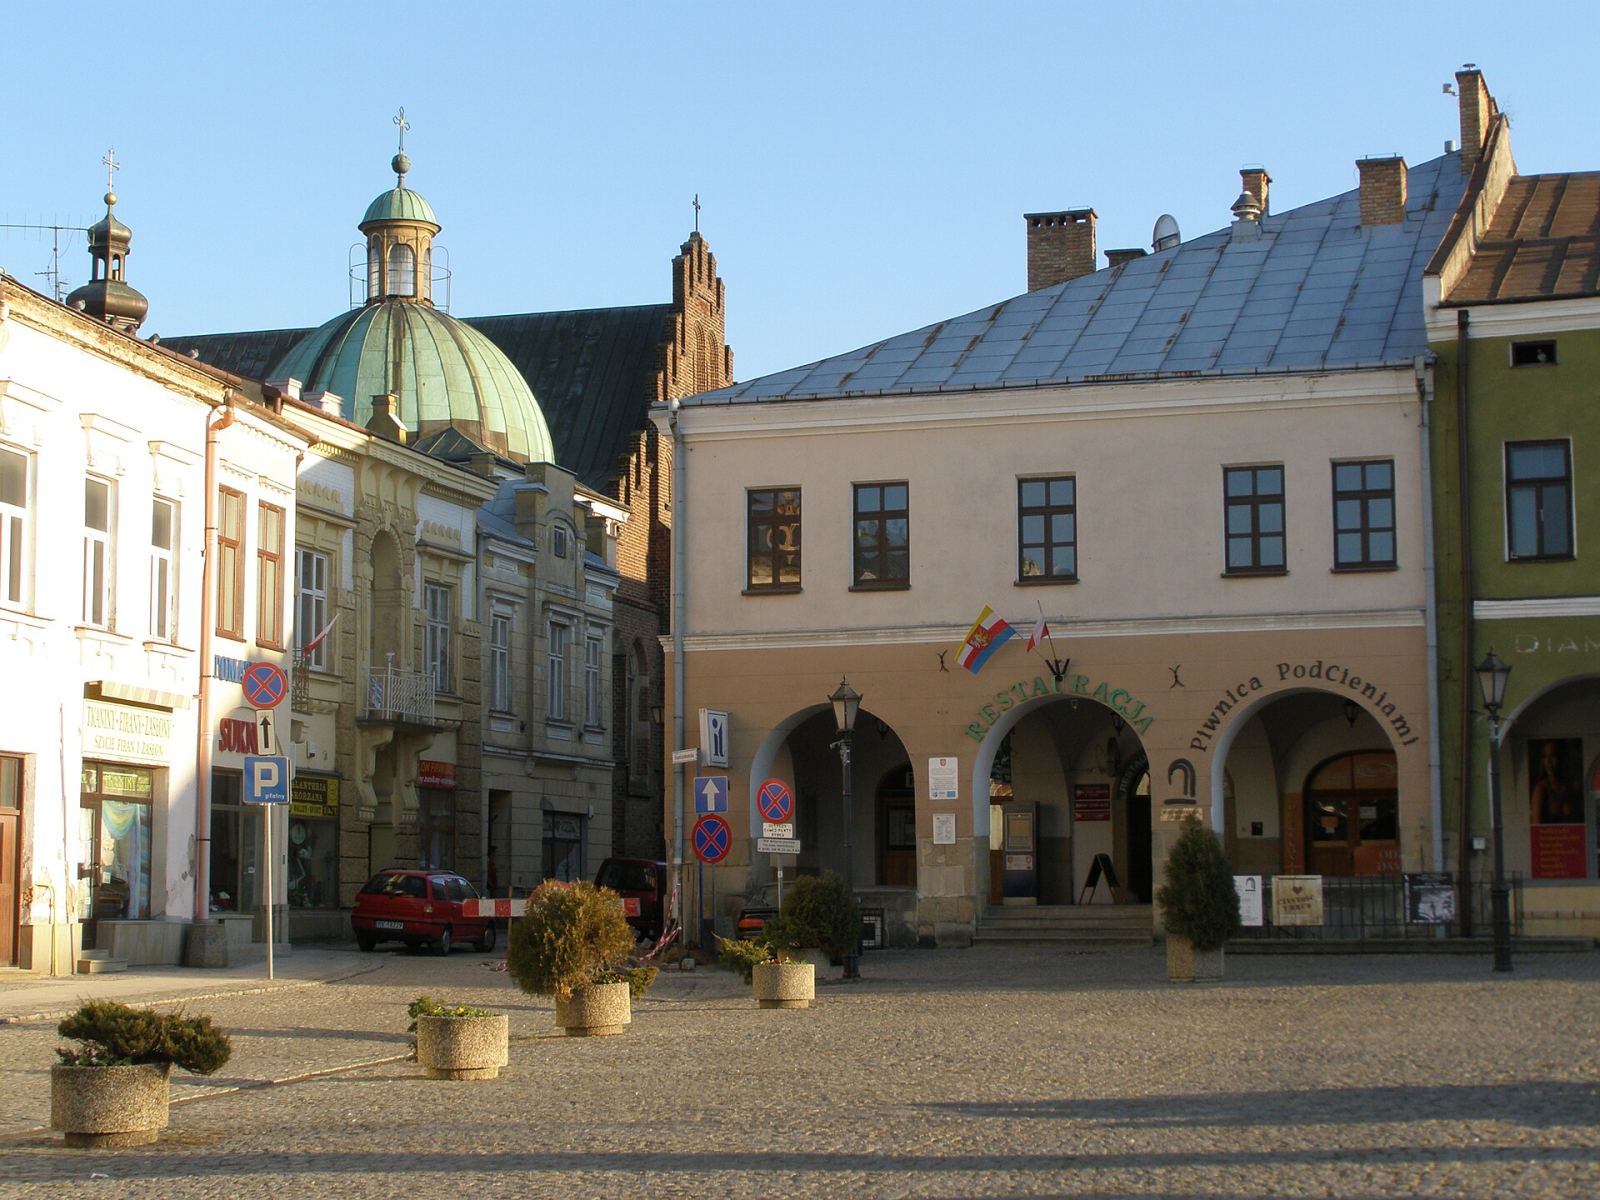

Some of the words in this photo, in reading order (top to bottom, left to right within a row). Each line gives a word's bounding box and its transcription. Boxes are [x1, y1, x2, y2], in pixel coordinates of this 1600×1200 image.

[87, 706, 117, 730] TKANINY
[119, 711, 142, 734] FIRANY
[964, 672, 1156, 743] RESTAURACJA
[1190, 674, 1264, 752] Piwnica
[218, 717, 259, 754] SUKN
[254, 761, 279, 797] P
